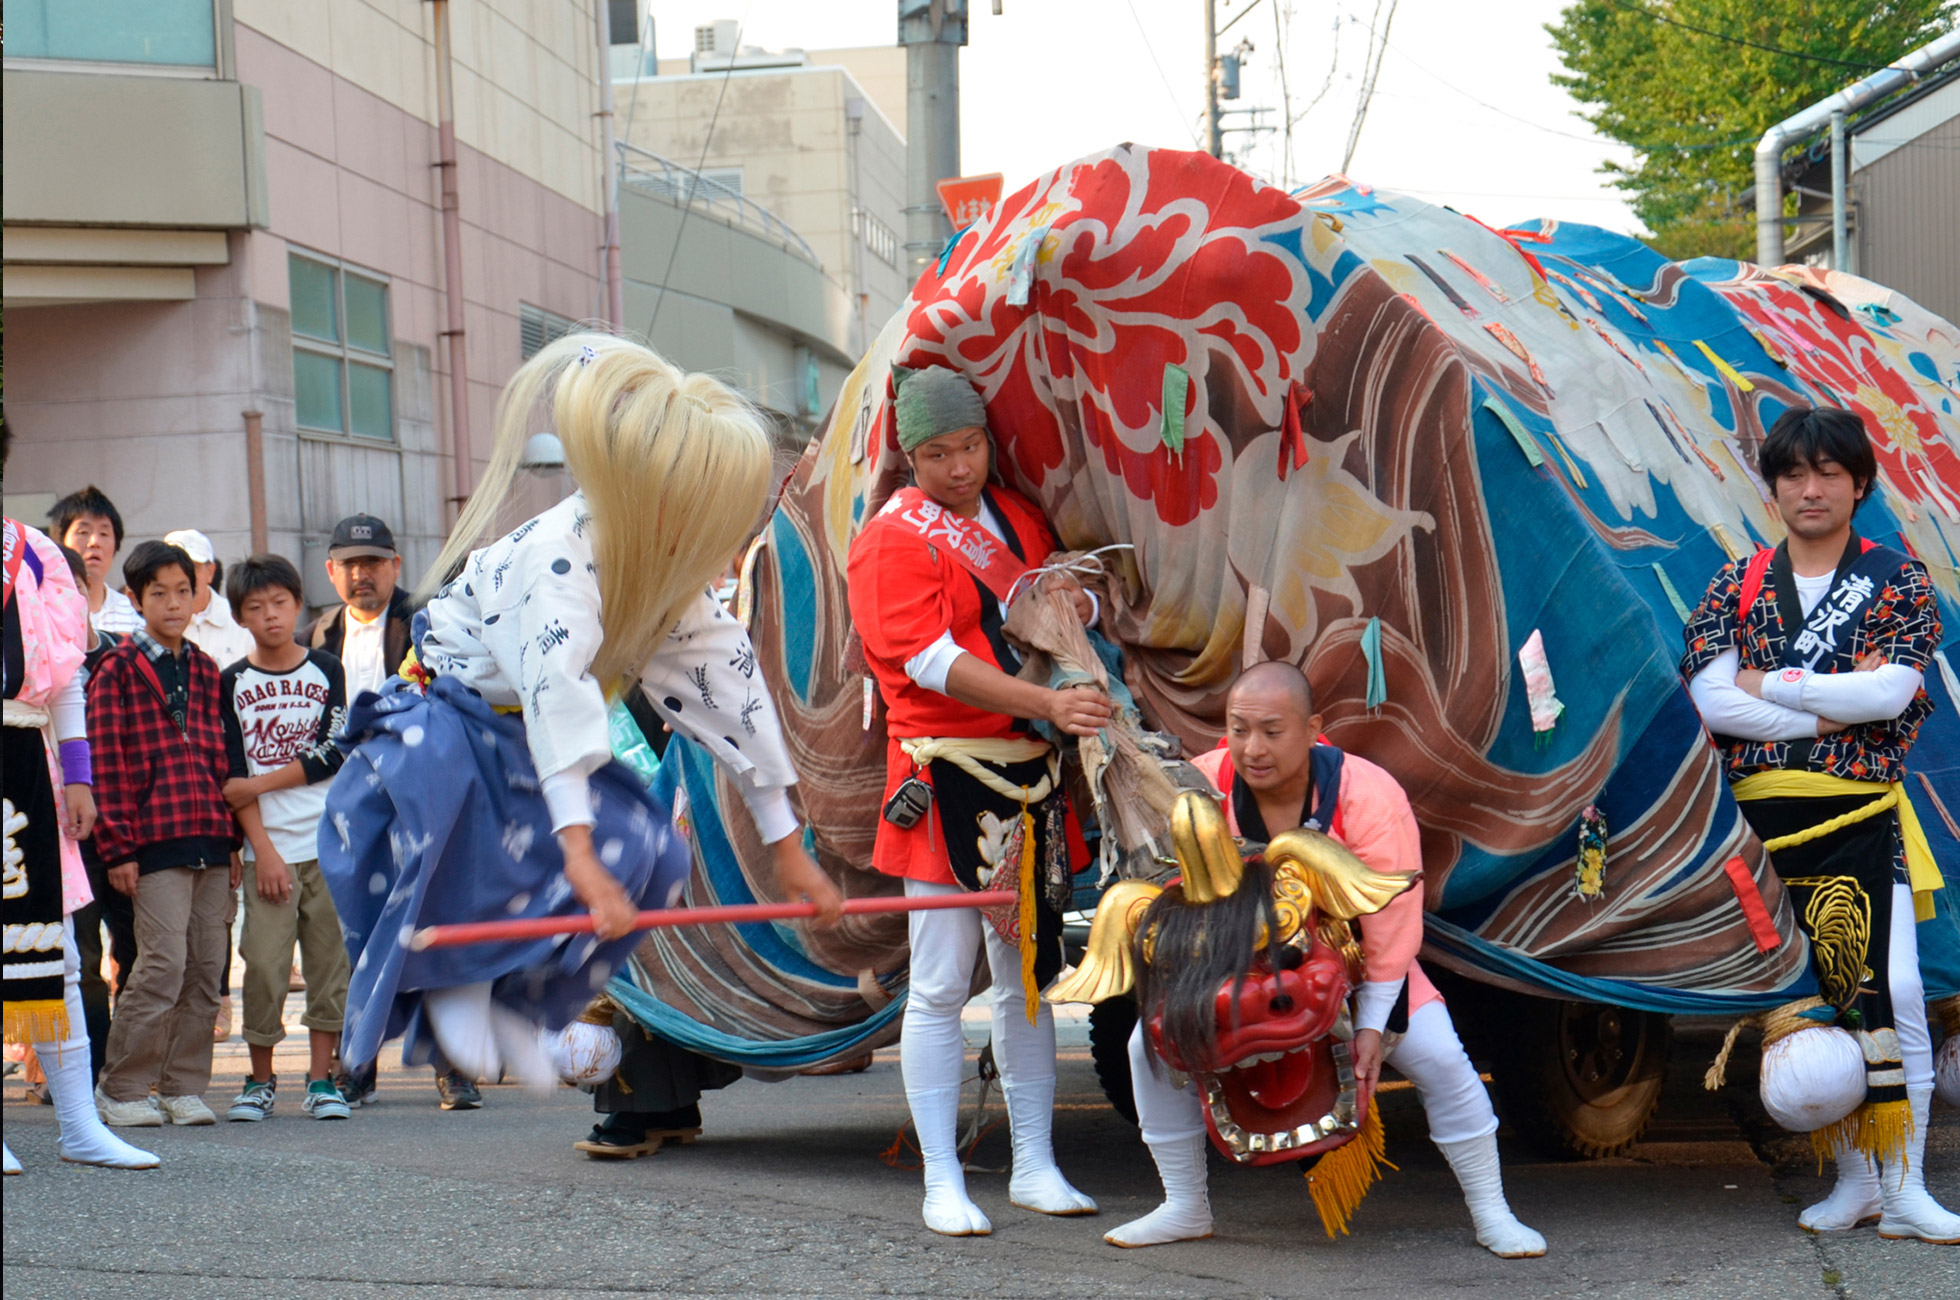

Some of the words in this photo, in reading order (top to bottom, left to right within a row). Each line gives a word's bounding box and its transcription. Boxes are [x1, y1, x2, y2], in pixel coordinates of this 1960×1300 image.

[1794, 573, 1875, 670] 清沢町
[236, 681, 277, 711] DRAG
[280, 679, 329, 705] RACES
